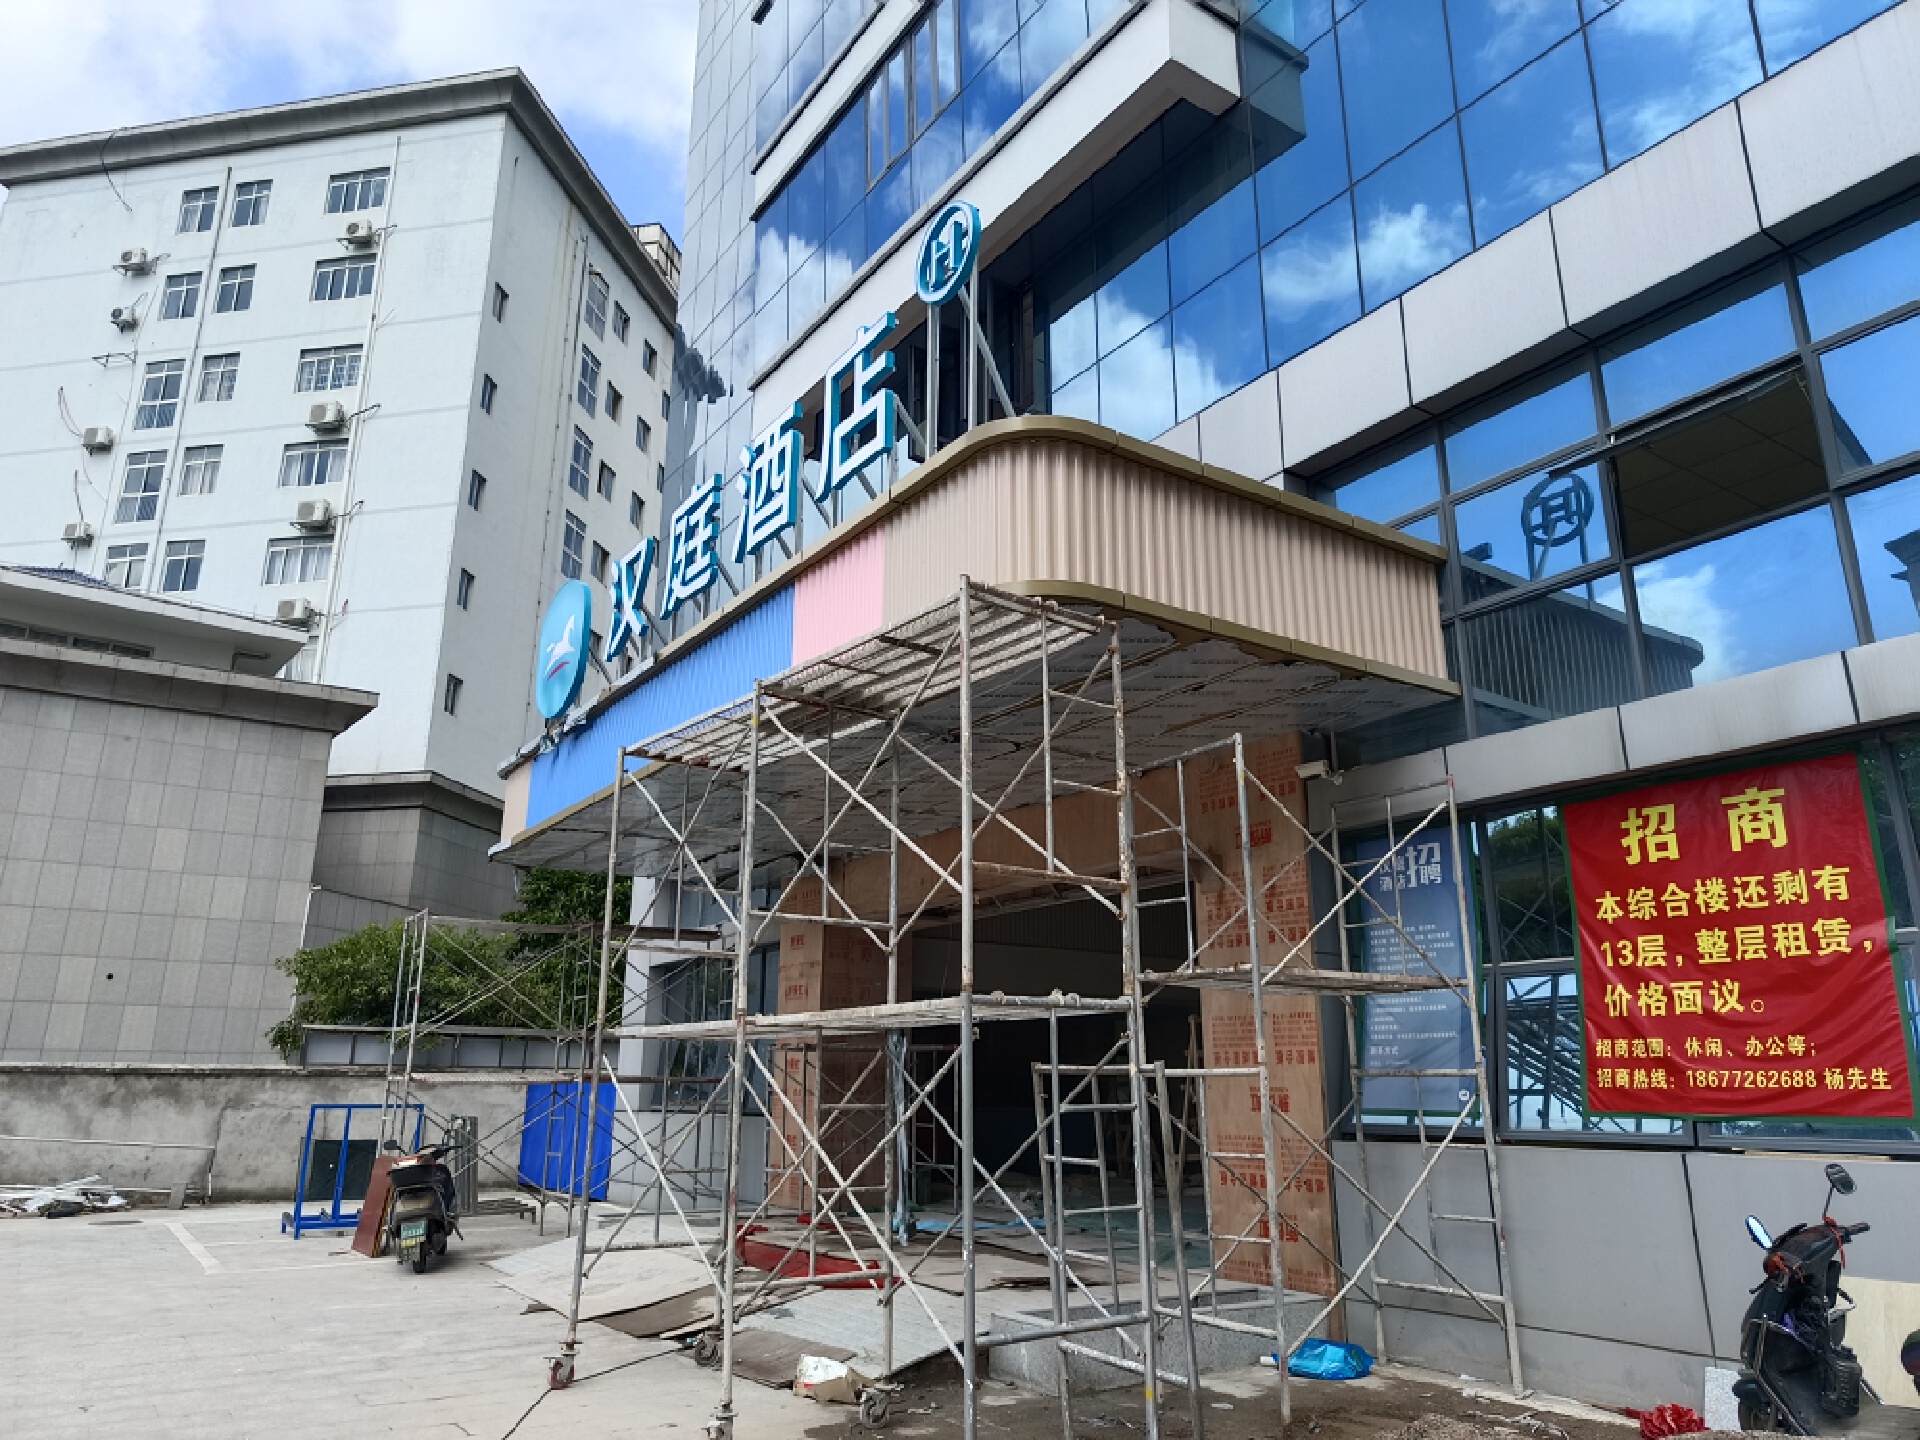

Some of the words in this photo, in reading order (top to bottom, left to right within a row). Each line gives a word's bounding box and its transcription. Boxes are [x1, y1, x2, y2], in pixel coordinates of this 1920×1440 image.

[604, 311, 899, 663] 汉庭酒店
[1619, 786, 1788, 865] 招商
[1596, 864, 1851, 925] 本综合楼还剩有
[1604, 978, 1766, 1018] 价格面议。
[1823, 1067, 1893, 1090] 杨先生
